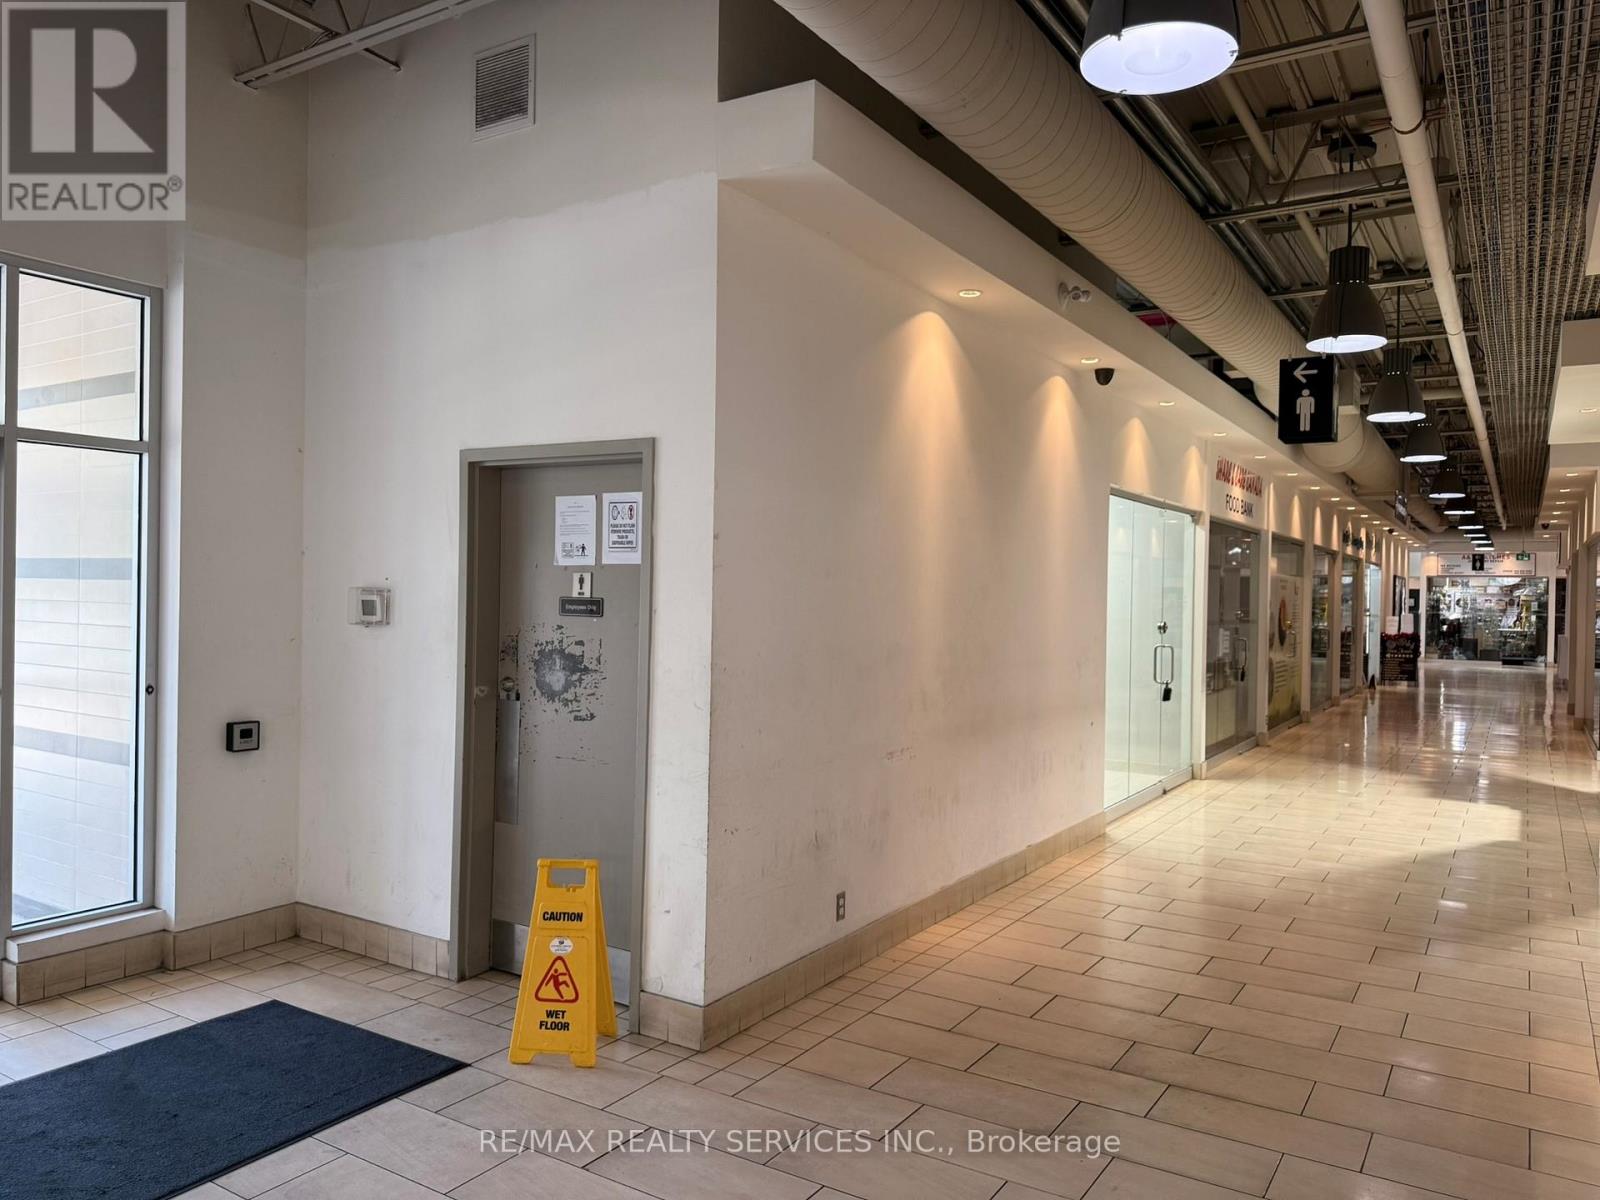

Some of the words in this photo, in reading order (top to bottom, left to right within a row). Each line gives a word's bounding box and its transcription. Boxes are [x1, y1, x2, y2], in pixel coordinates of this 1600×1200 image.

[1226, 493, 1240, 513] FOOD
[1240, 499, 1254, 519] BANK
[542, 911, 583, 922] CAUTION
[545, 1009, 567, 1019] WET
[539, 1020, 570, 1031] FLOOR
